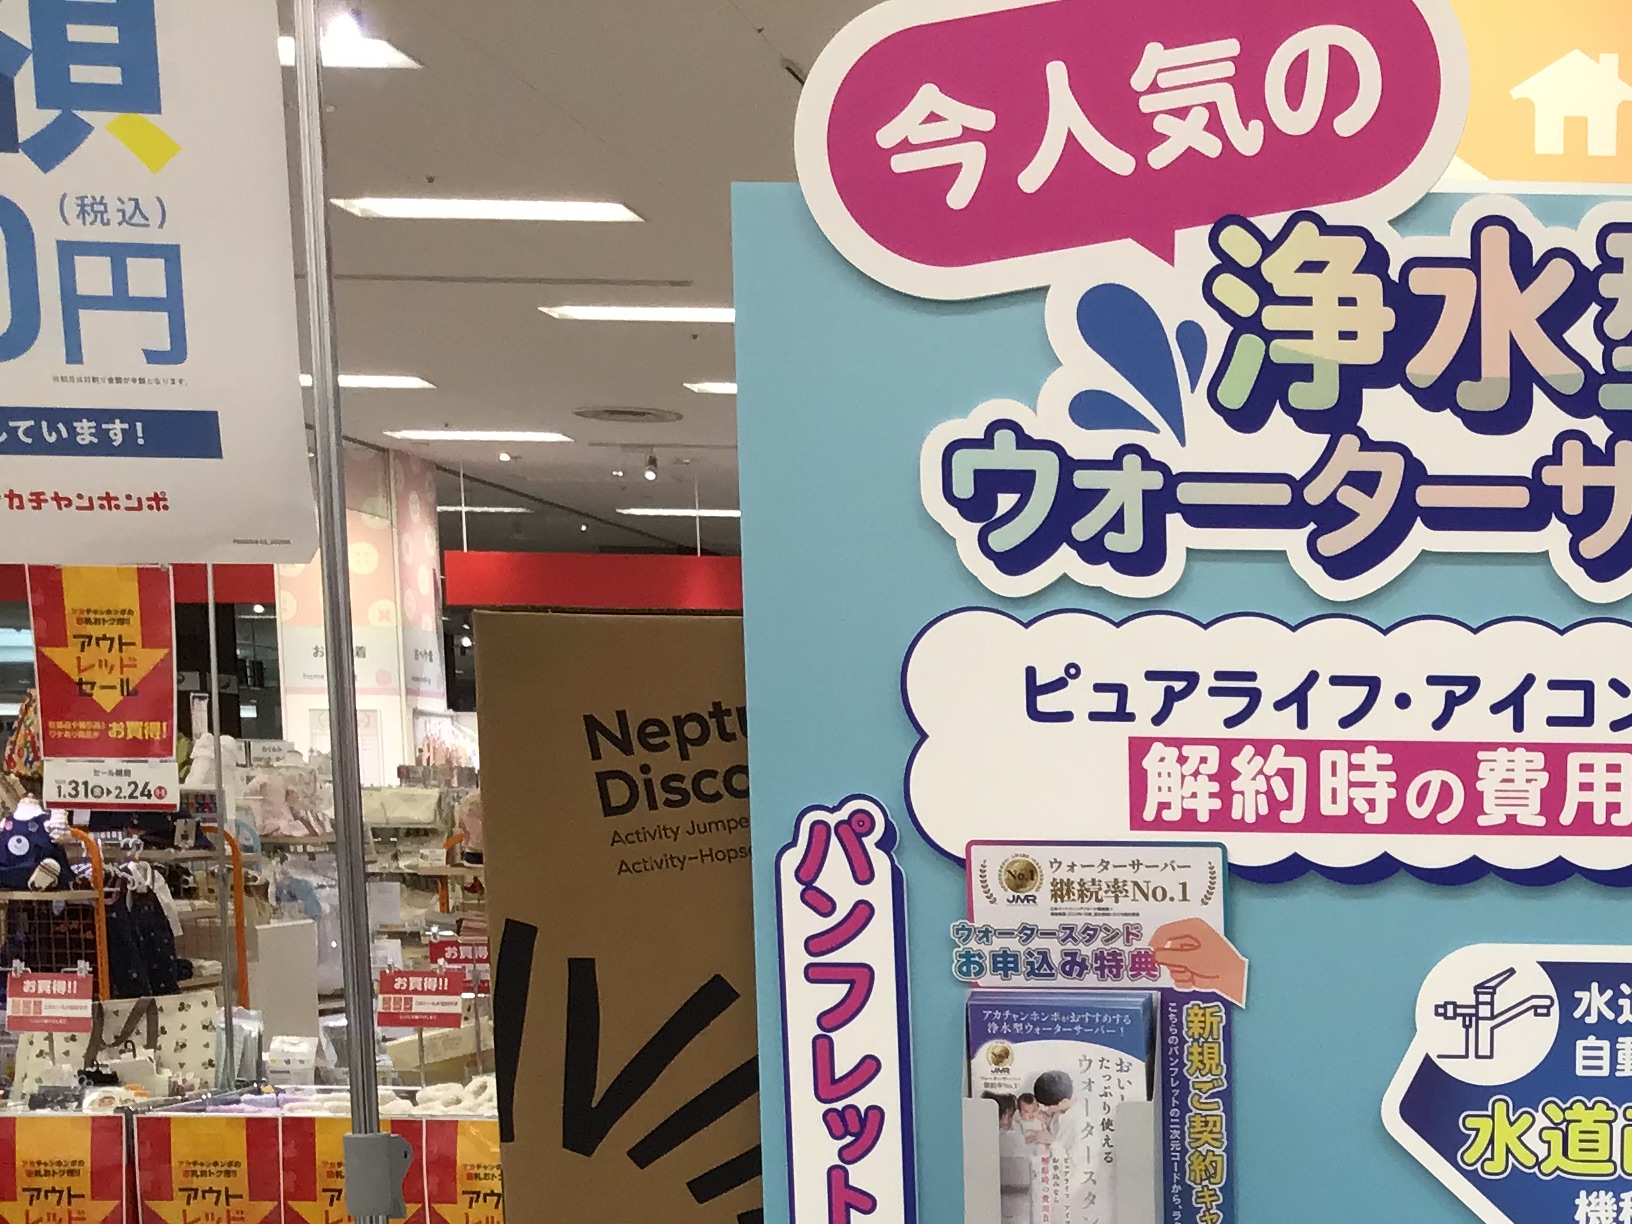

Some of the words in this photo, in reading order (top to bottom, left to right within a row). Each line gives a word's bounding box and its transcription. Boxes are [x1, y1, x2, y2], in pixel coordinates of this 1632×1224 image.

[876, 25, 1383, 210] 今人気の
[58, 193, 167, 229] (税込)
[0, 419, 145, 446] ています!
[0, 489, 170, 512] カチャンホンポ
[73, 634, 137, 653] アウト
[76, 656, 137, 675] レッド
[76, 678, 138, 697] セール
[610, 824, 680, 847] Activity
[1006, 868, 1035, 882] No.1
[1050, 858, 1191, 873] ウォーターサーバー
[1050, 877, 1191, 904] 継続率No.1
[952, 921, 1143, 946] ウォータースタンド
[954, 949, 1161, 982] お申込み特典
[1099, 1057, 1115, 1164] たっぷり使える
[22, 1186, 85, 1206] アウト
[178, 1186, 244, 1206] アウト
